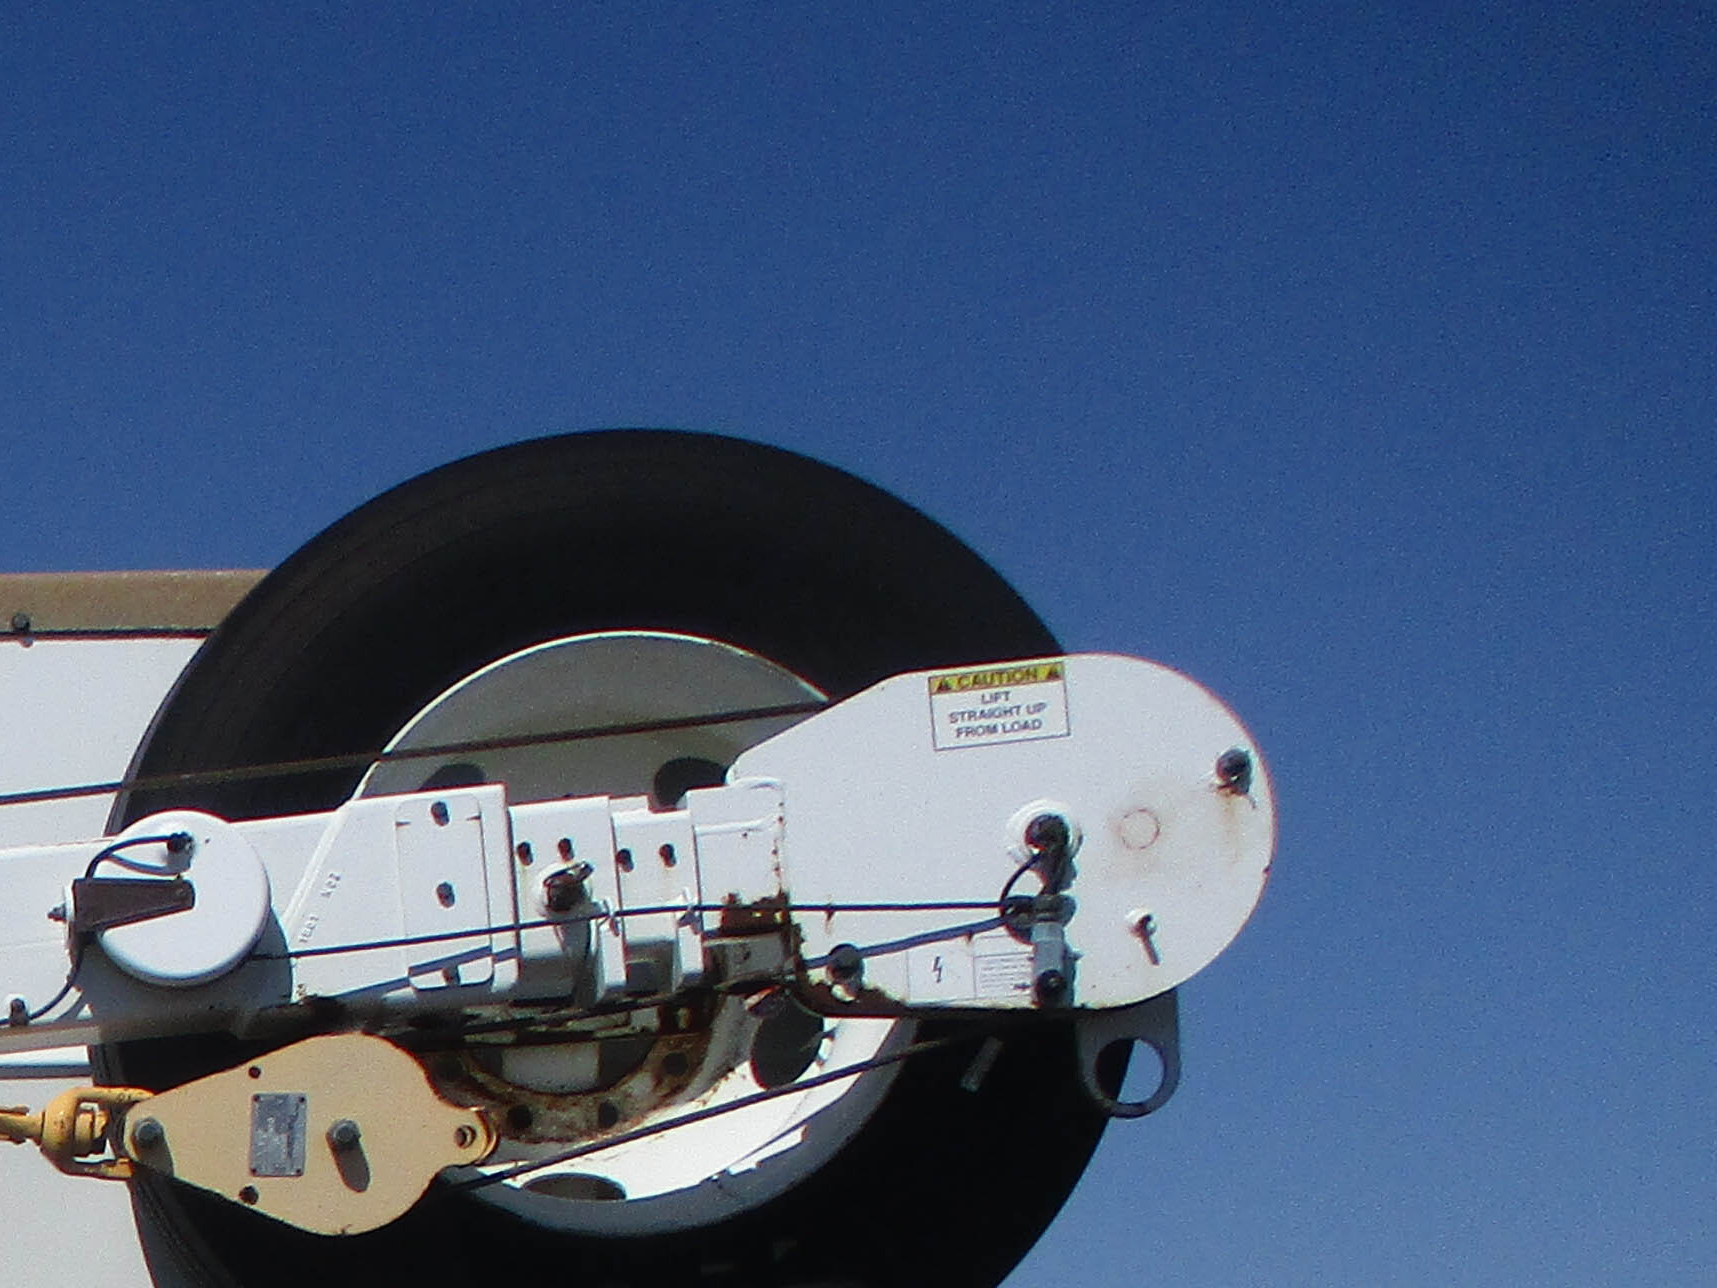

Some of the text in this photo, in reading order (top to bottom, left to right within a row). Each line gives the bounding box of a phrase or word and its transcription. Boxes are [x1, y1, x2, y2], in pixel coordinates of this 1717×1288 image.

[957, 667, 1038, 689] CAUTION
[981, 691, 1011, 704] LIFT
[949, 702, 1047, 724] STRAIGHT UP
[956, 719, 1043, 738] FROM LOAD
